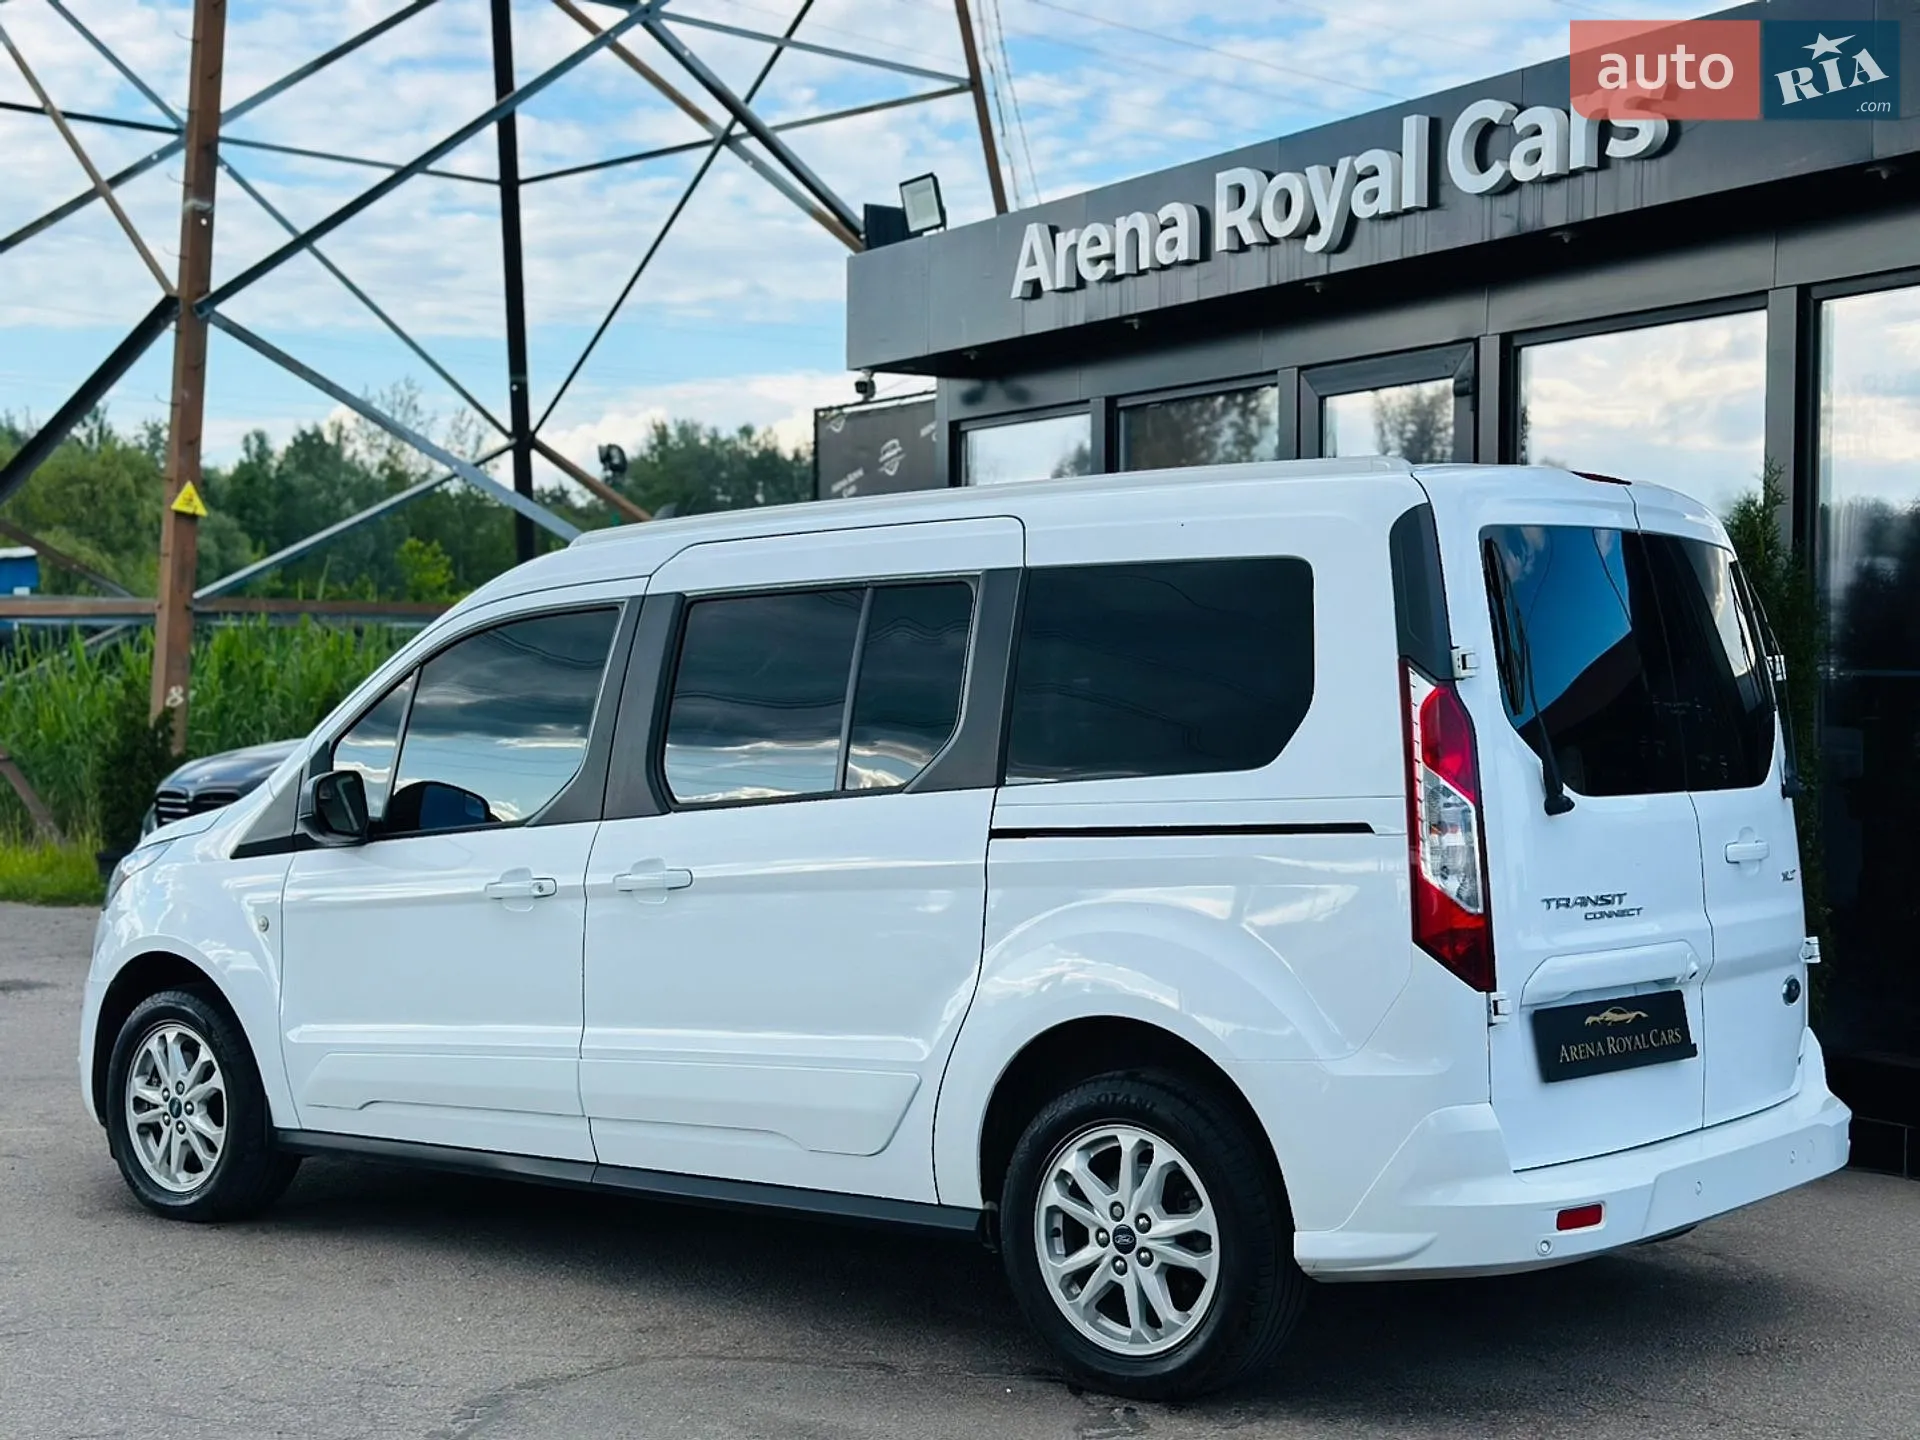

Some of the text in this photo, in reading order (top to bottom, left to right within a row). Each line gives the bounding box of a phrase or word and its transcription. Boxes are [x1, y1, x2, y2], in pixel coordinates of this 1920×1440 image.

[1010, 80, 1669, 298] Arena Royal Cars
[1541, 892, 1627, 911] TRANSIT
[1584, 907, 1643, 921] CONNECT
[1559, 1028, 1682, 1063] ARENA ROYAL CARS
